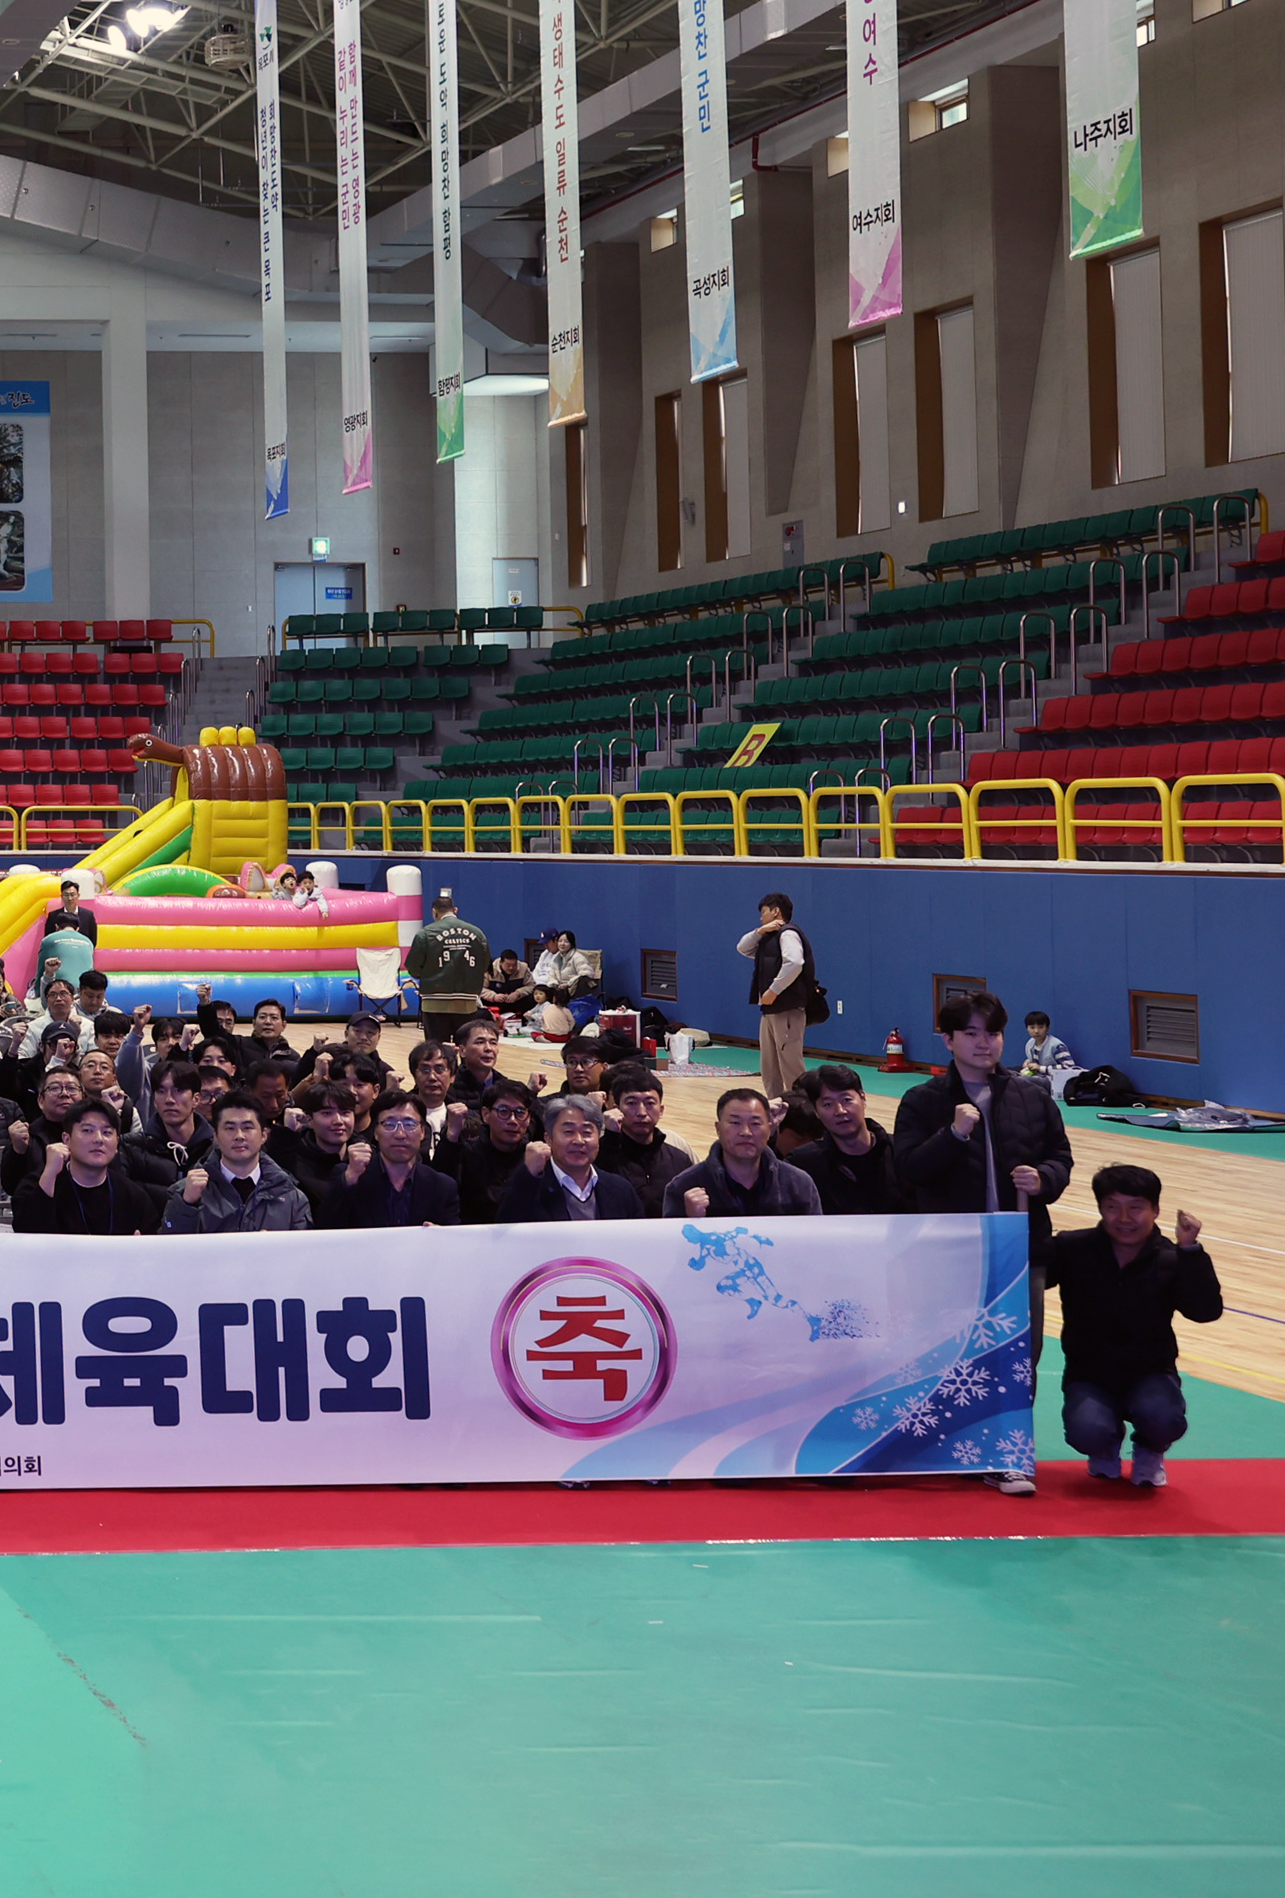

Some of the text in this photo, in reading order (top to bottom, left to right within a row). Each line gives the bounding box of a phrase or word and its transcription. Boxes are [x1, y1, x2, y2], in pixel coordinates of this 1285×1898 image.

[862, 12, 878, 85] 여수
[438, 62, 448, 111] 도약
[696, 69, 711, 133] 군민
[337, 47, 350, 231] 같이 누리는 군민
[348, 40, 361, 225] 함께 만드는 영광
[552, 12, 569, 263] 생태수도 일류 순천
[1073, 108, 1134, 152] 나주지회
[440, 120, 450, 200] 희망찬
[259, 105, 272, 302] 청년이 찾는 큰 목포
[852, 199, 895, 234] 여수지회
[441, 207, 452, 260] 함평
[692, 266, 730, 299] 곡성지회
[551, 325, 580, 353] 순천지회
[437, 372, 461, 397] 함평지회
[343, 410, 368, 433] 영광지회
[266, 441, 286, 462] 목포지회
[435, 927, 477, 942] BOSTON
[526, 1295, 643, 1402] 축
